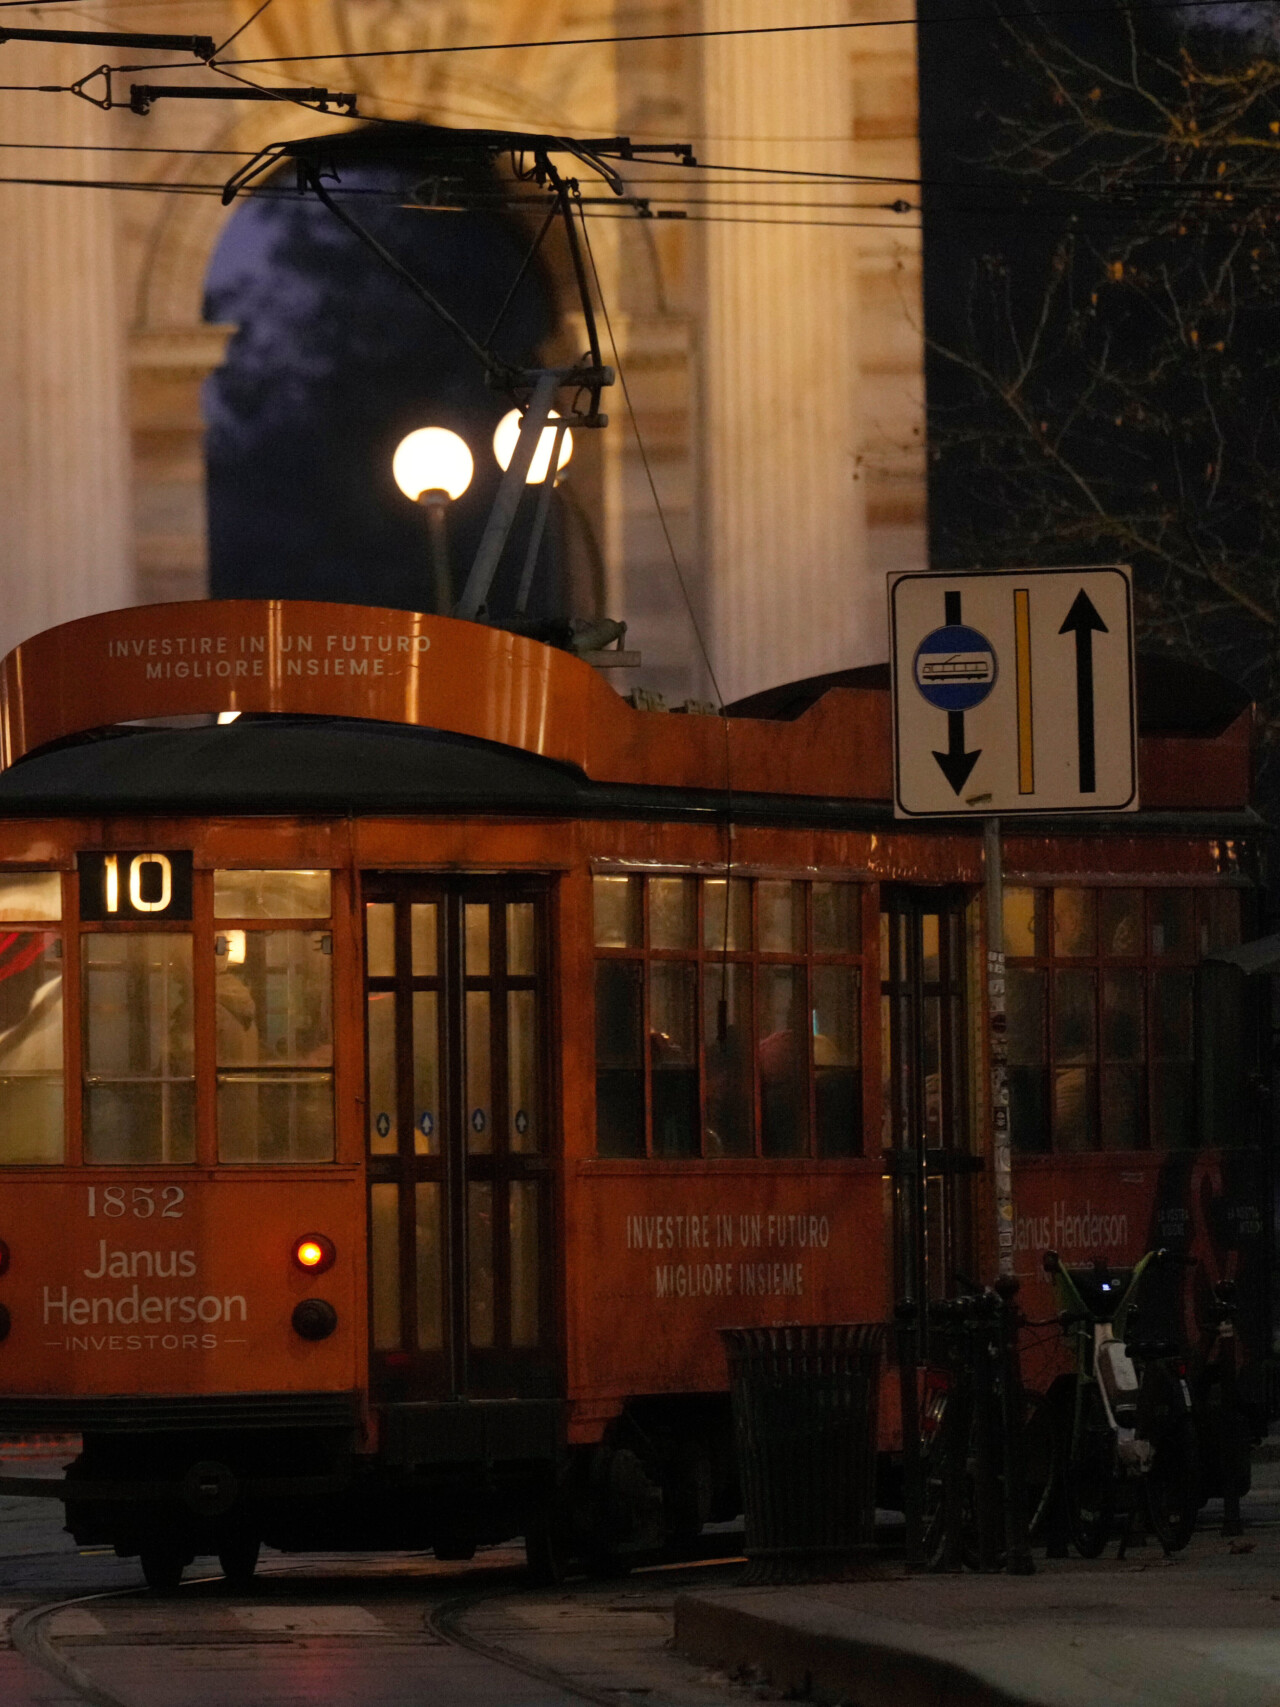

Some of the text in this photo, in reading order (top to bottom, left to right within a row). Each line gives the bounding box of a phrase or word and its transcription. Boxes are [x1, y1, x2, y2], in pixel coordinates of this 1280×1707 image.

[109, 634, 431, 657] INVESTIRE IN UN FUTURO
[146, 660, 264, 680] MIGLIORE
[104, 852, 173, 913] 10
[87, 1185, 186, 1218] 1852
[626, 1214, 830, 1249] INVESTIRE IN UN FUTURO
[1054, 1199, 1128, 1250] Henderson
[83, 1239, 198, 1279] Janus
[655, 1262, 804, 1299] MIGLIORE INSIEME
[43, 1284, 247, 1325] Henderson
[65, 1333, 218, 1351] INVESTORS
